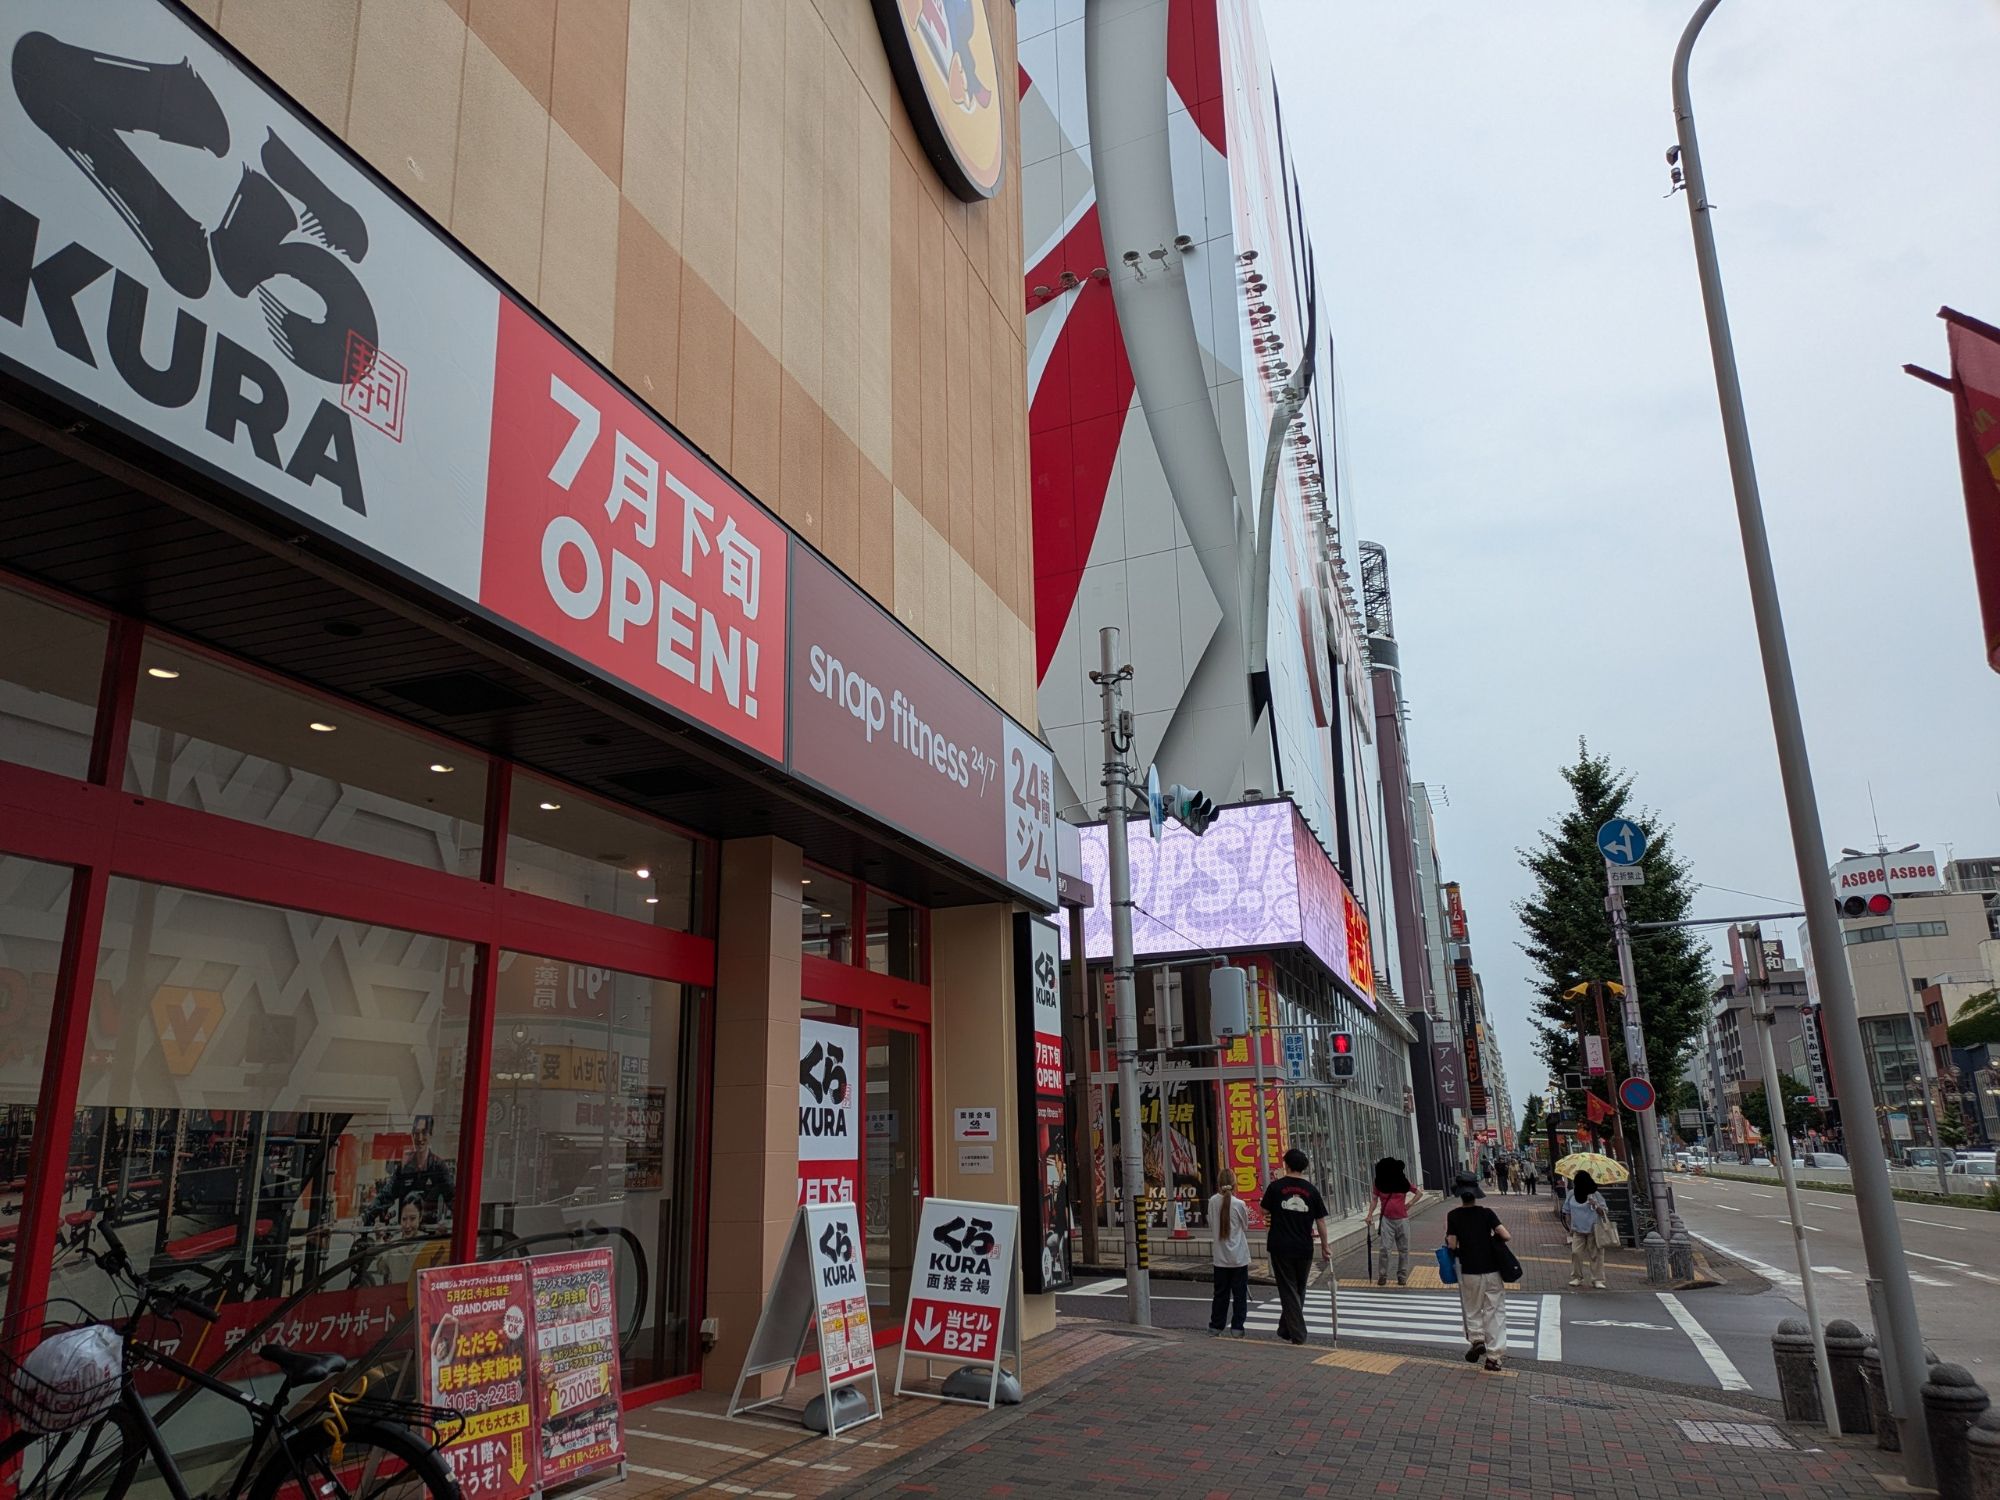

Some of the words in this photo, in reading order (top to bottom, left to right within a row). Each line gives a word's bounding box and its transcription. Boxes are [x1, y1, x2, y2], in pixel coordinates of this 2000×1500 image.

[12, 29, 380, 384] くら
[0, 194, 367, 518] KURA
[547, 373, 762, 622] 7月下旬
[541, 515, 760, 720] OPEN!
[808, 643, 886, 743] snap
[890, 688, 970, 790] fitness
[970, 744, 997, 798] 24/7
[1016, 820, 1052, 885] ジム
[1611, 871, 1643, 881] 右折禁止
[1841, 868, 1884, 888] ASBee
[1889, 864, 1936, 880] ASBee
[1035, 951, 1056, 989] くら
[1763, 941, 1782, 970] 東和
[1036, 987, 1057, 1008] KURA
[1036, 1042, 1061, 1067] 7月下旬
[800, 1040, 848, 1105] くら
[1036, 1068, 1062, 1089] OPEN!
[1438, 1047, 1456, 1094] アペゼ
[799, 1106, 848, 1137] KURA
[1228, 1082, 1258, 1193] 左折です
[820, 1221, 852, 1264] くら
[933, 1216, 995, 1256] くら
[823, 1264, 857, 1288] KURA
[929, 1253, 992, 1277] KURA
[927, 1273, 990, 1295] 面接会場
[452, 1303, 481, 1316] GRAND
[946, 1310, 993, 1332] 当ビル
[456, 1329, 504, 1358] ただ今、
[508, 1324, 519, 1334] OK
[943, 1330, 988, 1353] B2F
[437, 1355, 523, 1392] 見学会実施中
